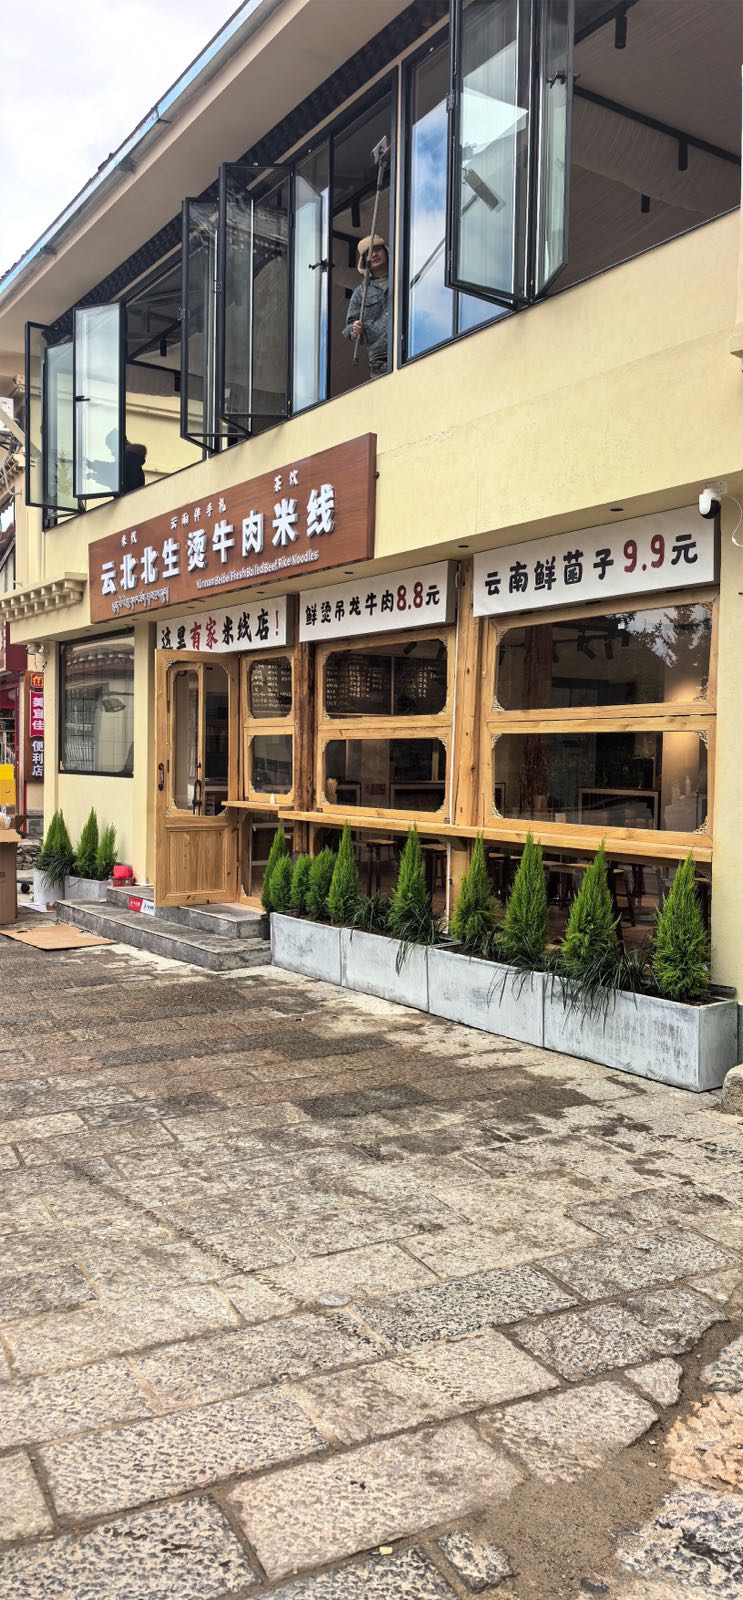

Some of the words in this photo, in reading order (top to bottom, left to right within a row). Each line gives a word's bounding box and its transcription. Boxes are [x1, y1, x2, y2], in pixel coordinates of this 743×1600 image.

[101, 484, 335, 596] 云北北生烫牛肉米线
[230, 567, 248, 582] Fresh
[264, 559, 279, 573] Beef
[278, 556, 292, 569] Rice
[291, 549, 319, 566] Noodles
[485, 534, 698, 596] 云南鲜菌子9.9元
[305, 582, 440, 626] 鲜烫吊龙牛肉8.8元
[32, 697, 44, 731] 美宜佳
[32, 741, 44, 777] 便利店
